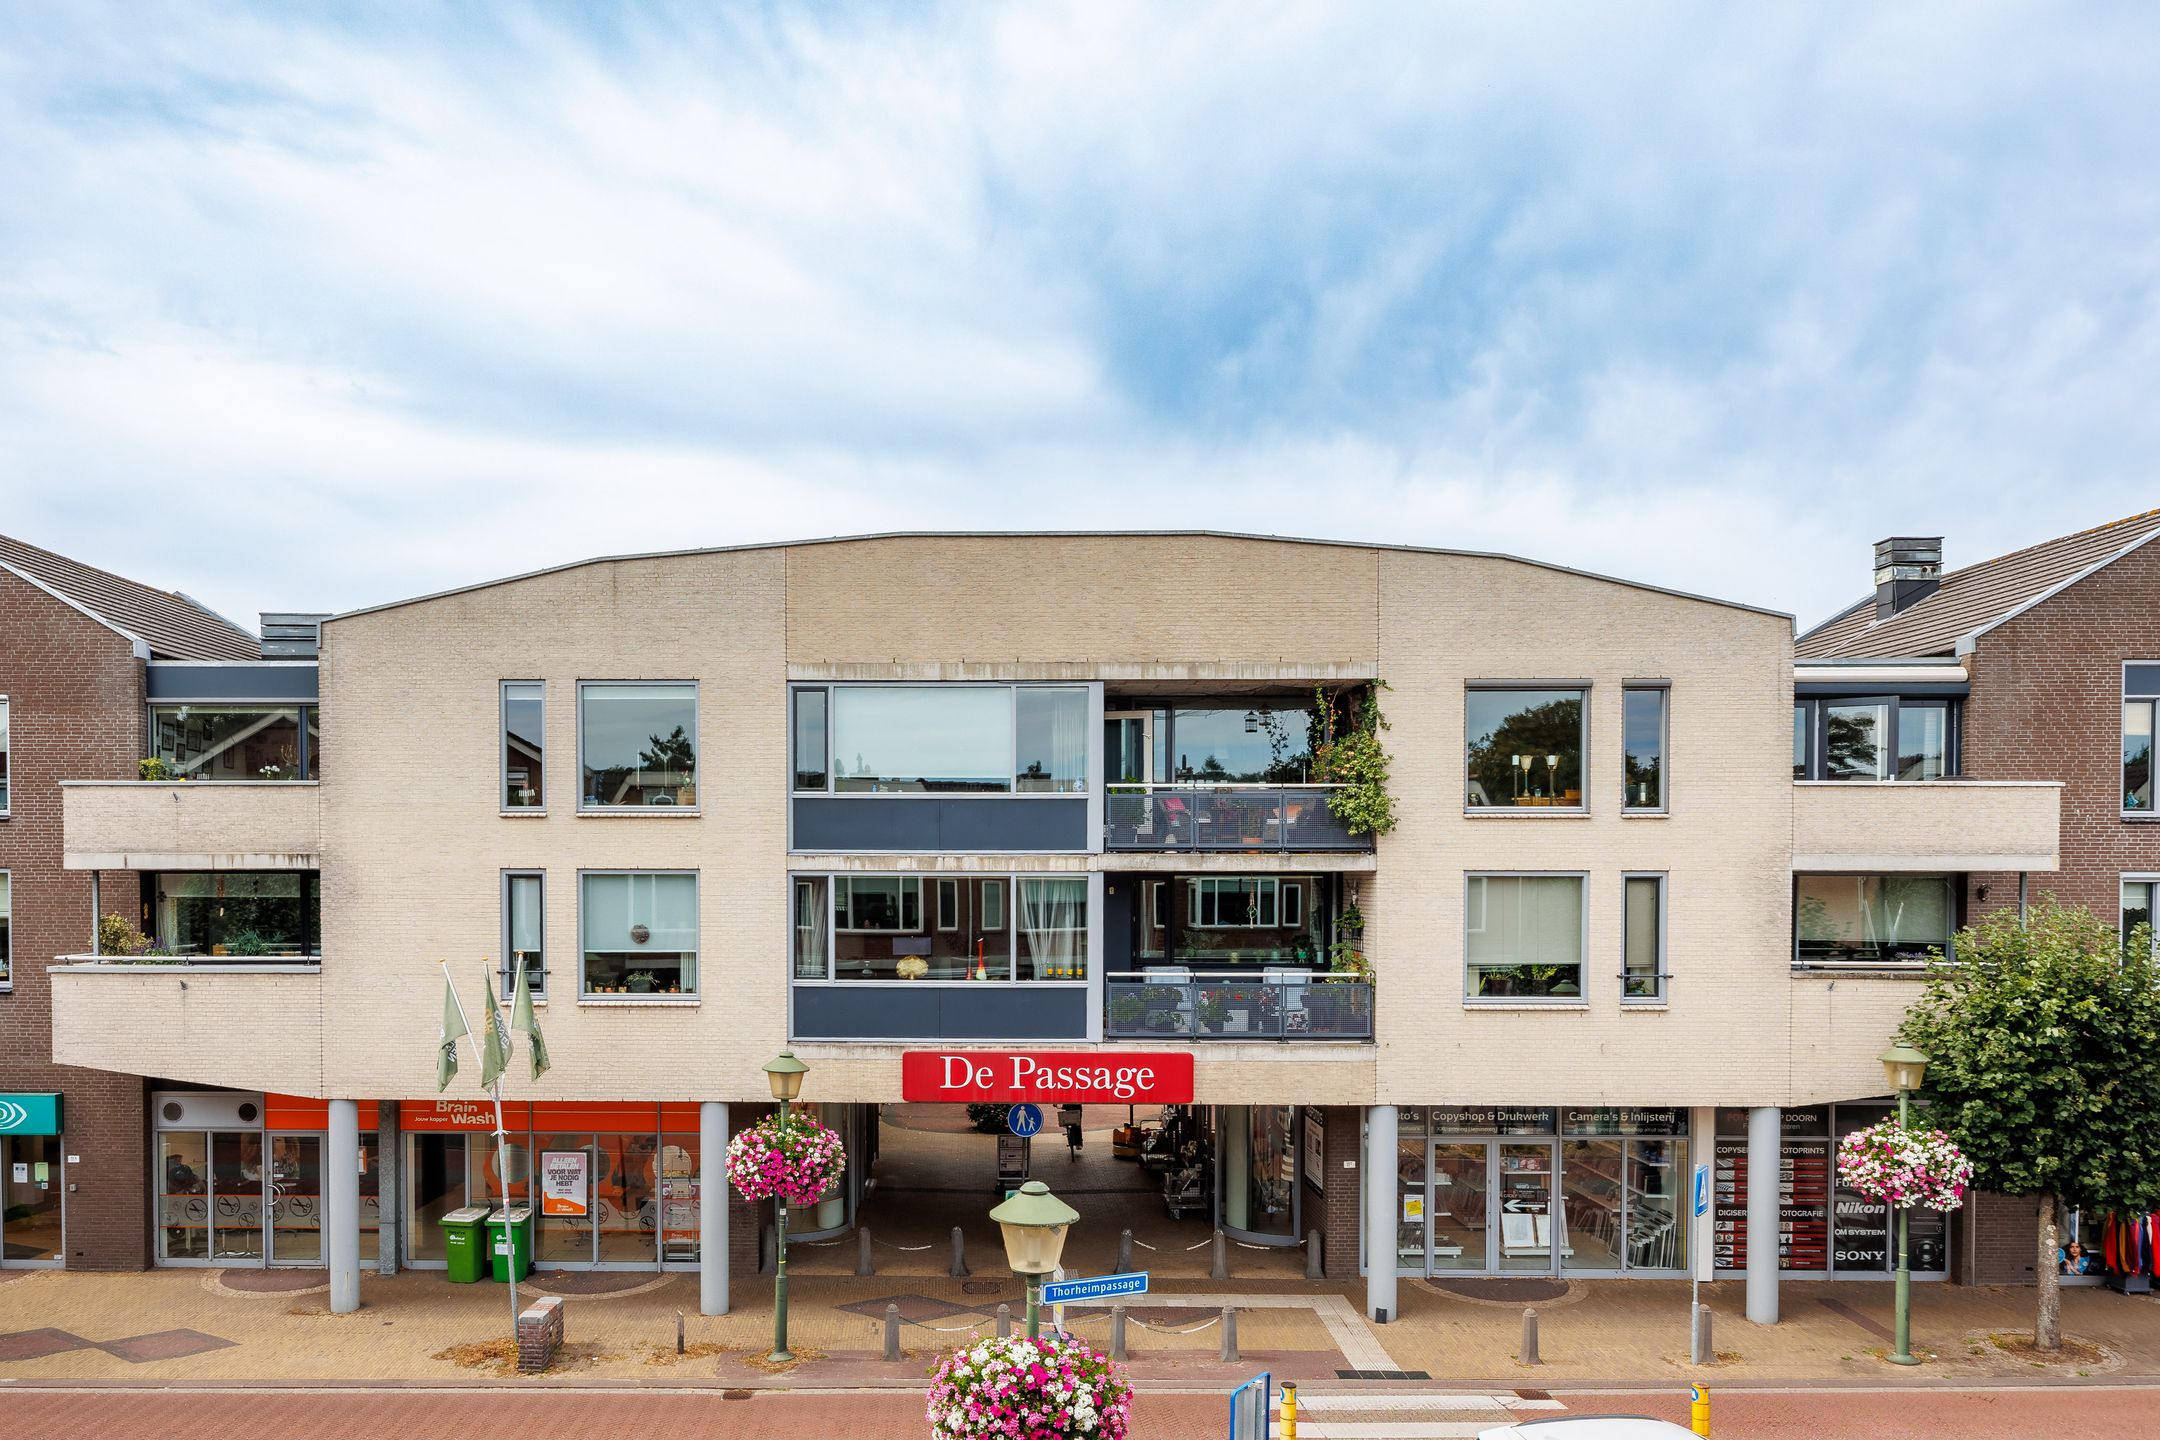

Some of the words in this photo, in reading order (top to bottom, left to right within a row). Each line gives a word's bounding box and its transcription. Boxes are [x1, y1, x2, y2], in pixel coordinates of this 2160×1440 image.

[940, 1056, 994, 1089] De
[1008, 1056, 1156, 1099] Passage
[436, 1100, 478, 1113] Brain
[451, 1112, 496, 1125] Wash
[1397, 1111, 1420, 1121] to's
[1432, 1111, 1485, 1123] Copyshop
[1487, 1111, 1495, 1121] &
[1497, 1111, 1549, 1121] Drukwerk
[1569, 1111, 1619, 1121] Camera's
[1620, 1111, 1628, 1121] &
[1630, 1111, 1675, 1123] Inlijsterij
[1785, 1114, 1817, 1122] DOORN
[1716, 1146, 1749, 1154] COPYSE
[1718, 1209, 1748, 1217] DIGISER
[1836, 1202, 1886, 1214] Nikon
[1834, 1228, 1847, 1236] OM
[1835, 1250, 1886, 1261] SONY
[1052, 1280, 1141, 1297] Thorheimpassage
